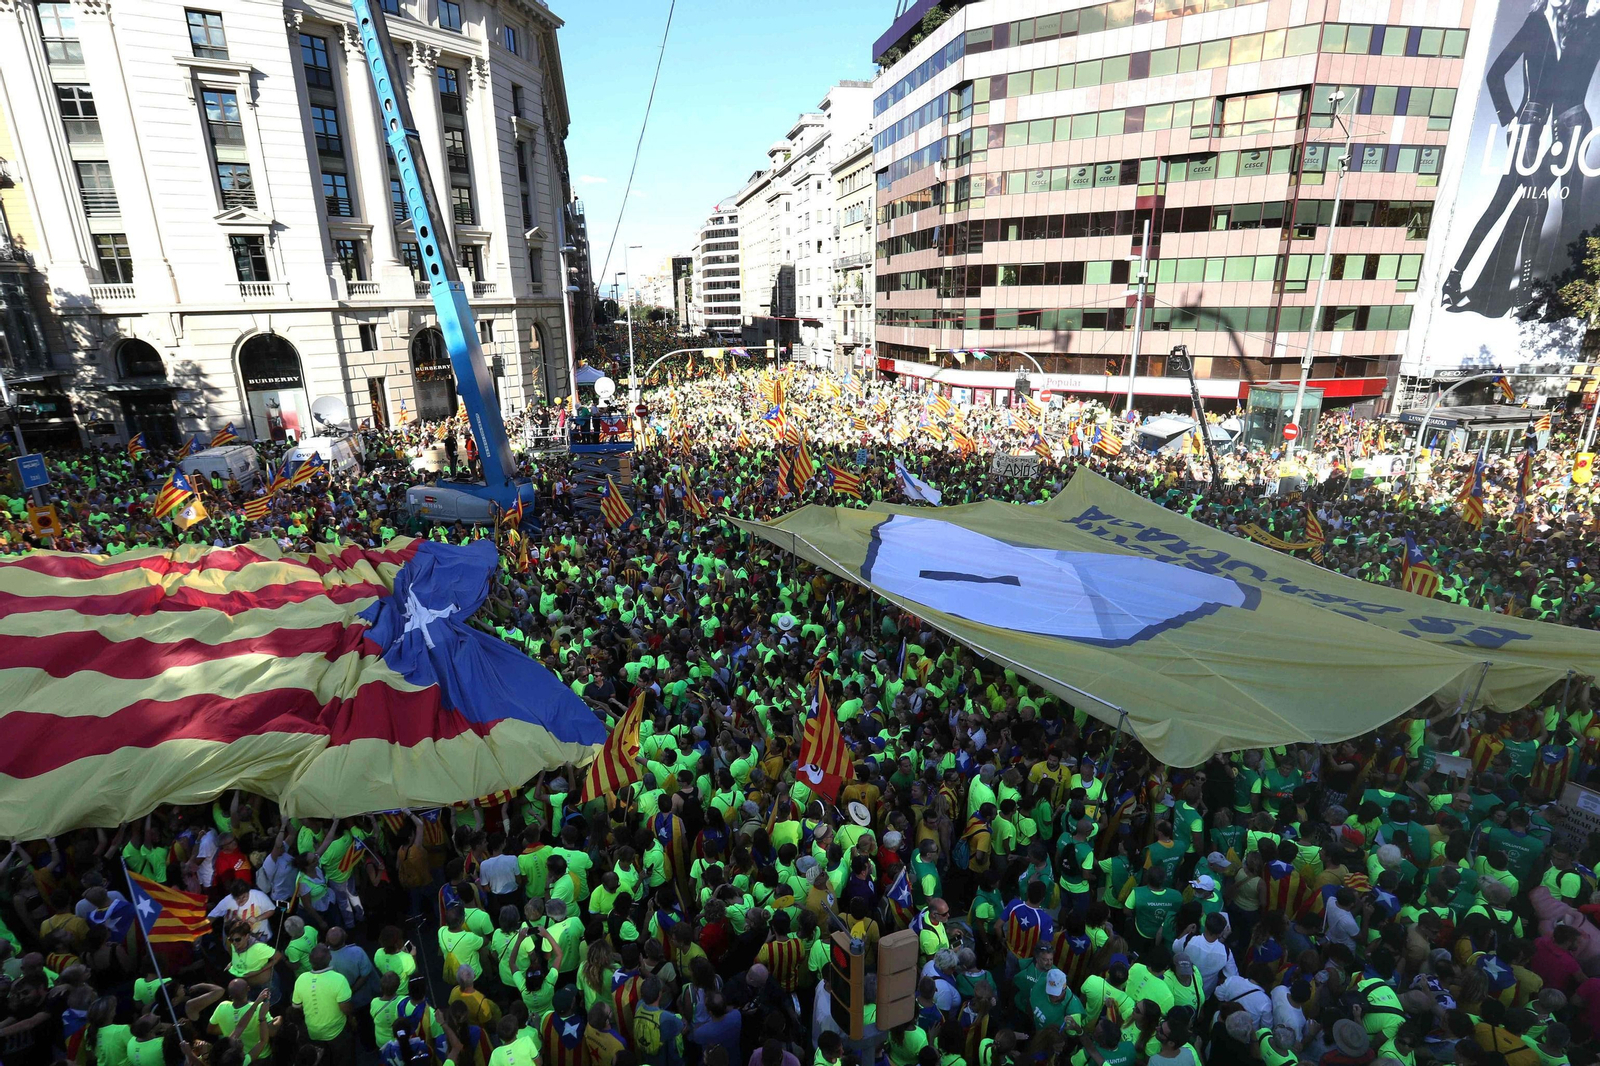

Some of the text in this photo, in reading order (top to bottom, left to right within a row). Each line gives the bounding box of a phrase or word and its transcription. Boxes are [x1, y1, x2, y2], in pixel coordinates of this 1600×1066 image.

[1244, 161, 1264, 169] CESCE
[1522, 186, 1570, 200] MILANO
[415, 364, 451, 372] BURBERRY
[248, 376, 300, 385] BURBERRY
[1046, 377, 1082, 388] Popular
